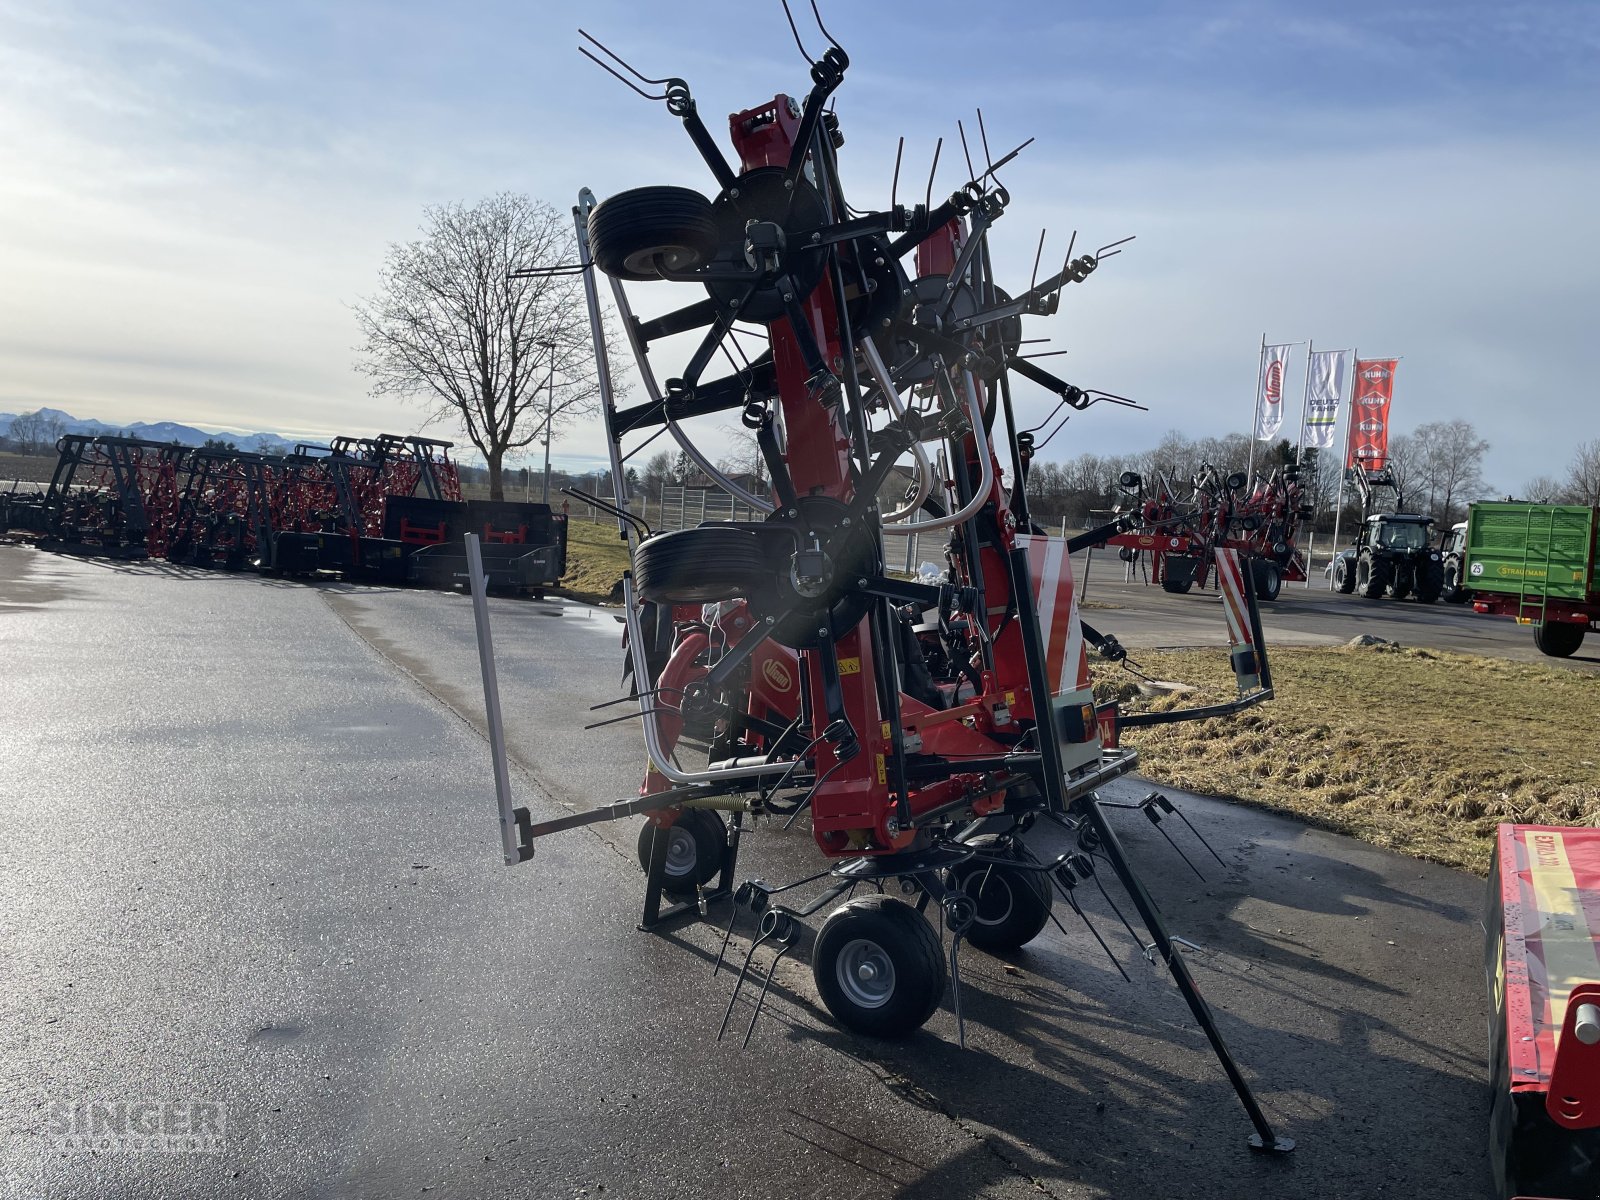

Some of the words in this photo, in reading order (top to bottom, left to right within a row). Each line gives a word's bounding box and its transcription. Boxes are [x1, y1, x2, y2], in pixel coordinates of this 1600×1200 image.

[1361, 397, 1385, 405] KUHN
[1311, 404, 1336, 412] FAHR
[1360, 422, 1382, 431] KUHN
[1357, 448, 1378, 456] KUHN
[1472, 564, 1481, 574] 25
[765, 660, 789, 688] Vicon
[1535, 836, 1557, 855] EXTRA
